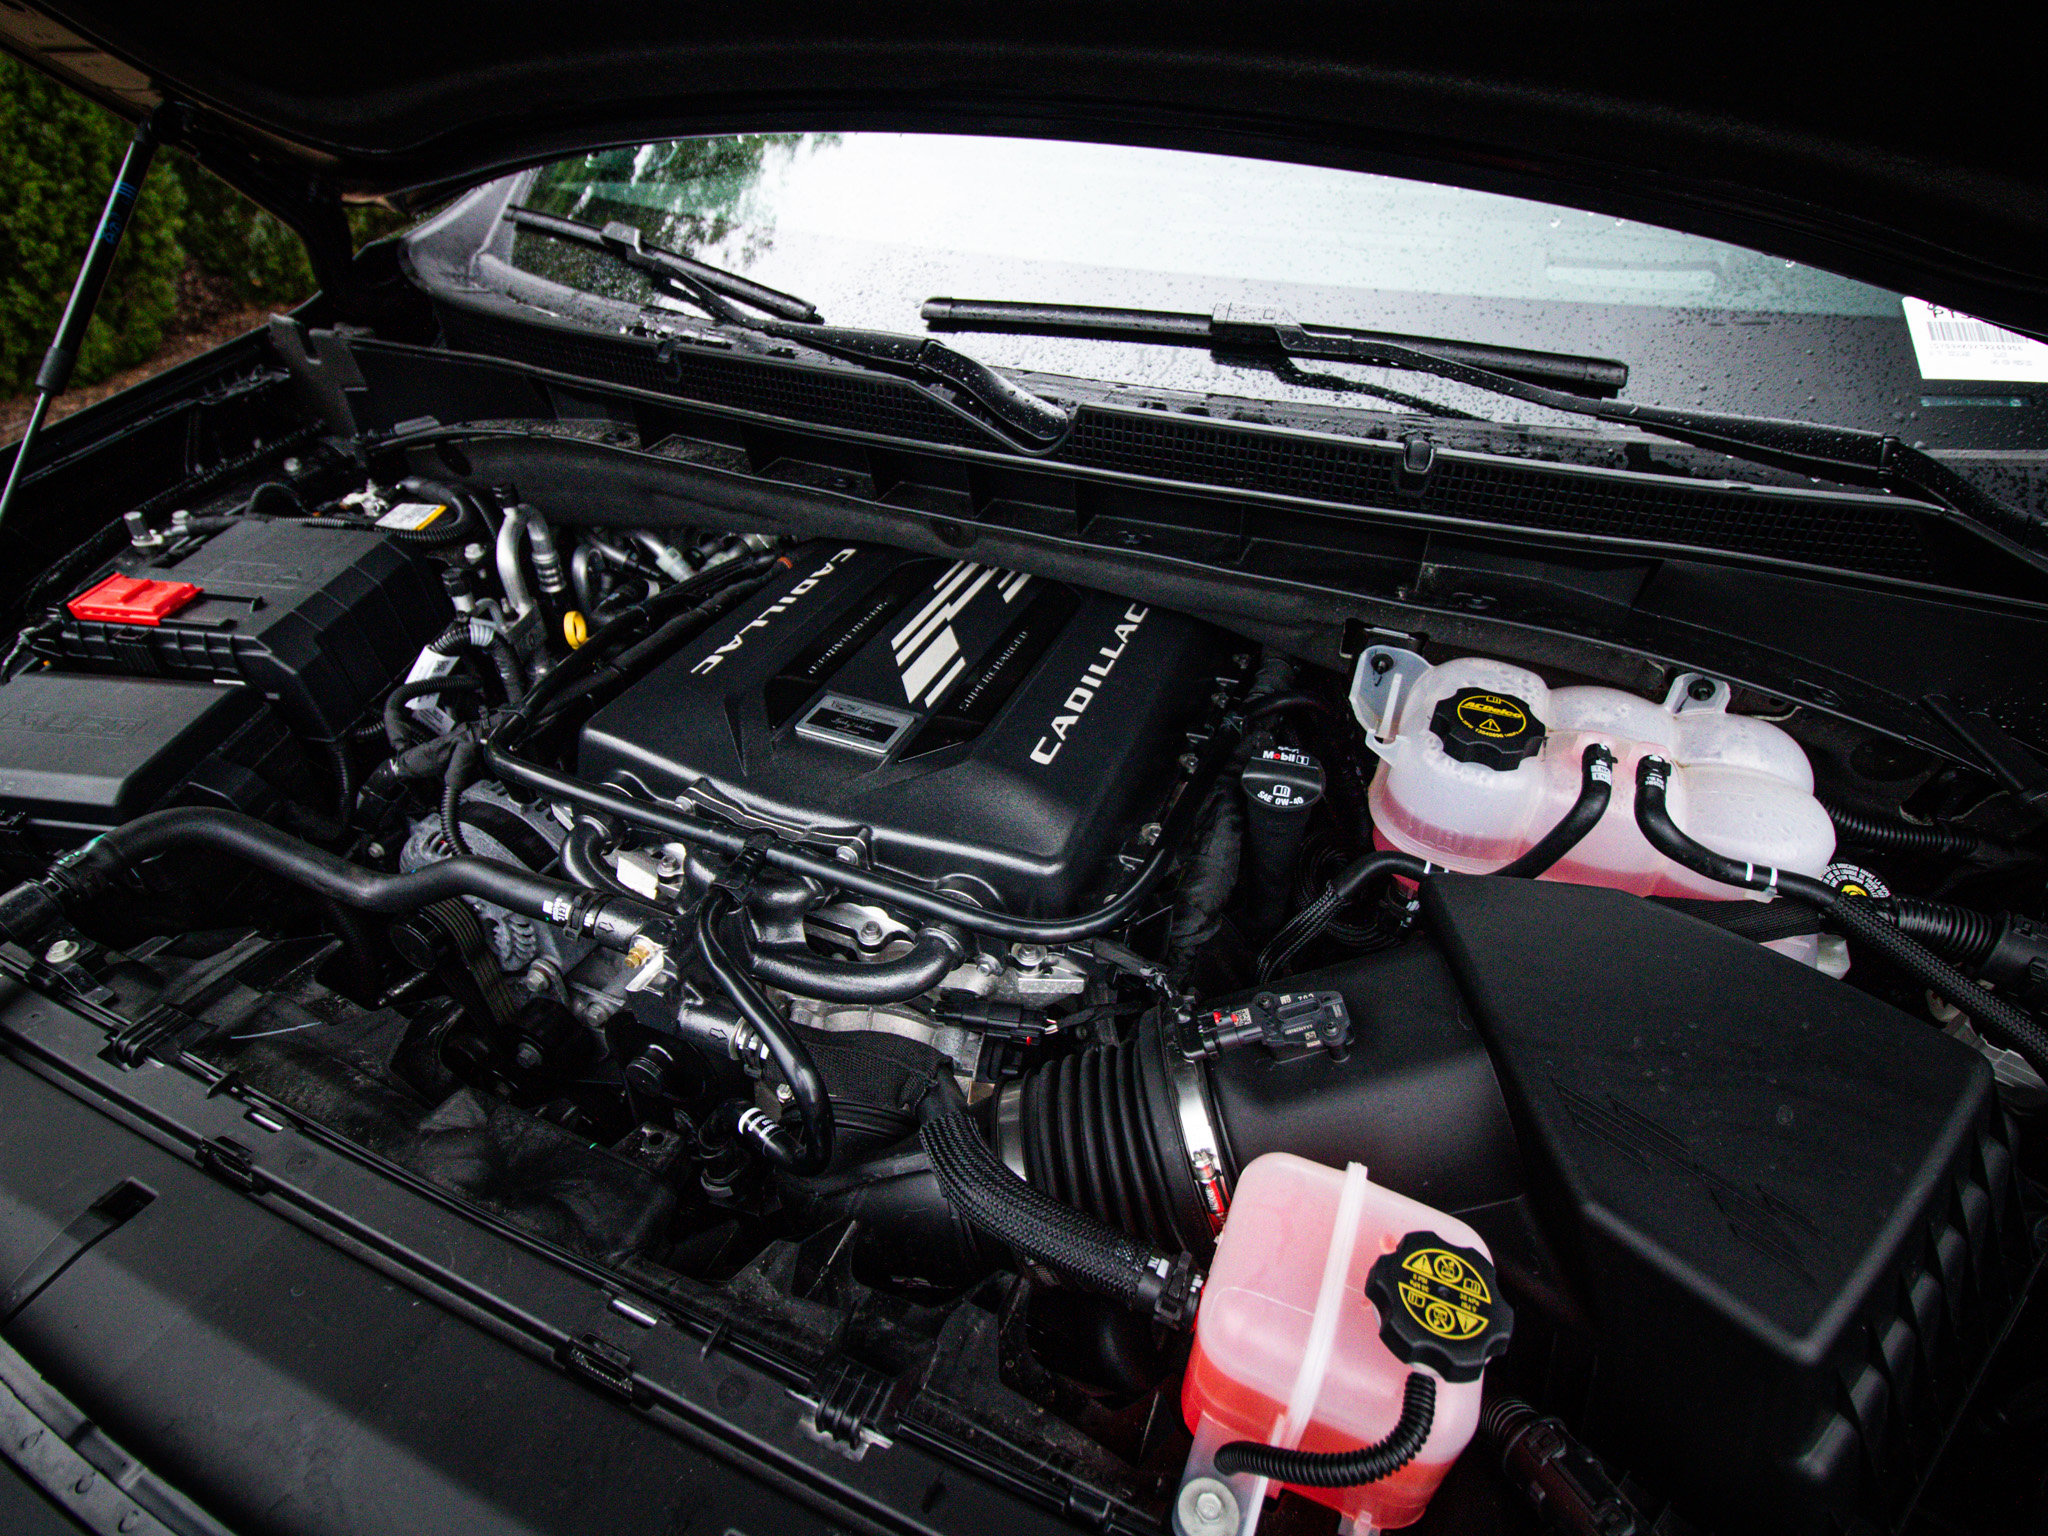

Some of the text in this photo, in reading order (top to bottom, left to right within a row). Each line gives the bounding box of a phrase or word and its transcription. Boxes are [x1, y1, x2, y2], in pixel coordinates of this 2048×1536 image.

[691, 548, 857, 675] CADILLAC
[958, 630, 1029, 712] SUPERCHARGED
[1029, 604, 1150, 765] CADILLAC
[1462, 701, 1522, 719] ACDelco
[1262, 750, 1296, 762] Mobil
[1257, 790, 1304, 806] SAE 0W-40
